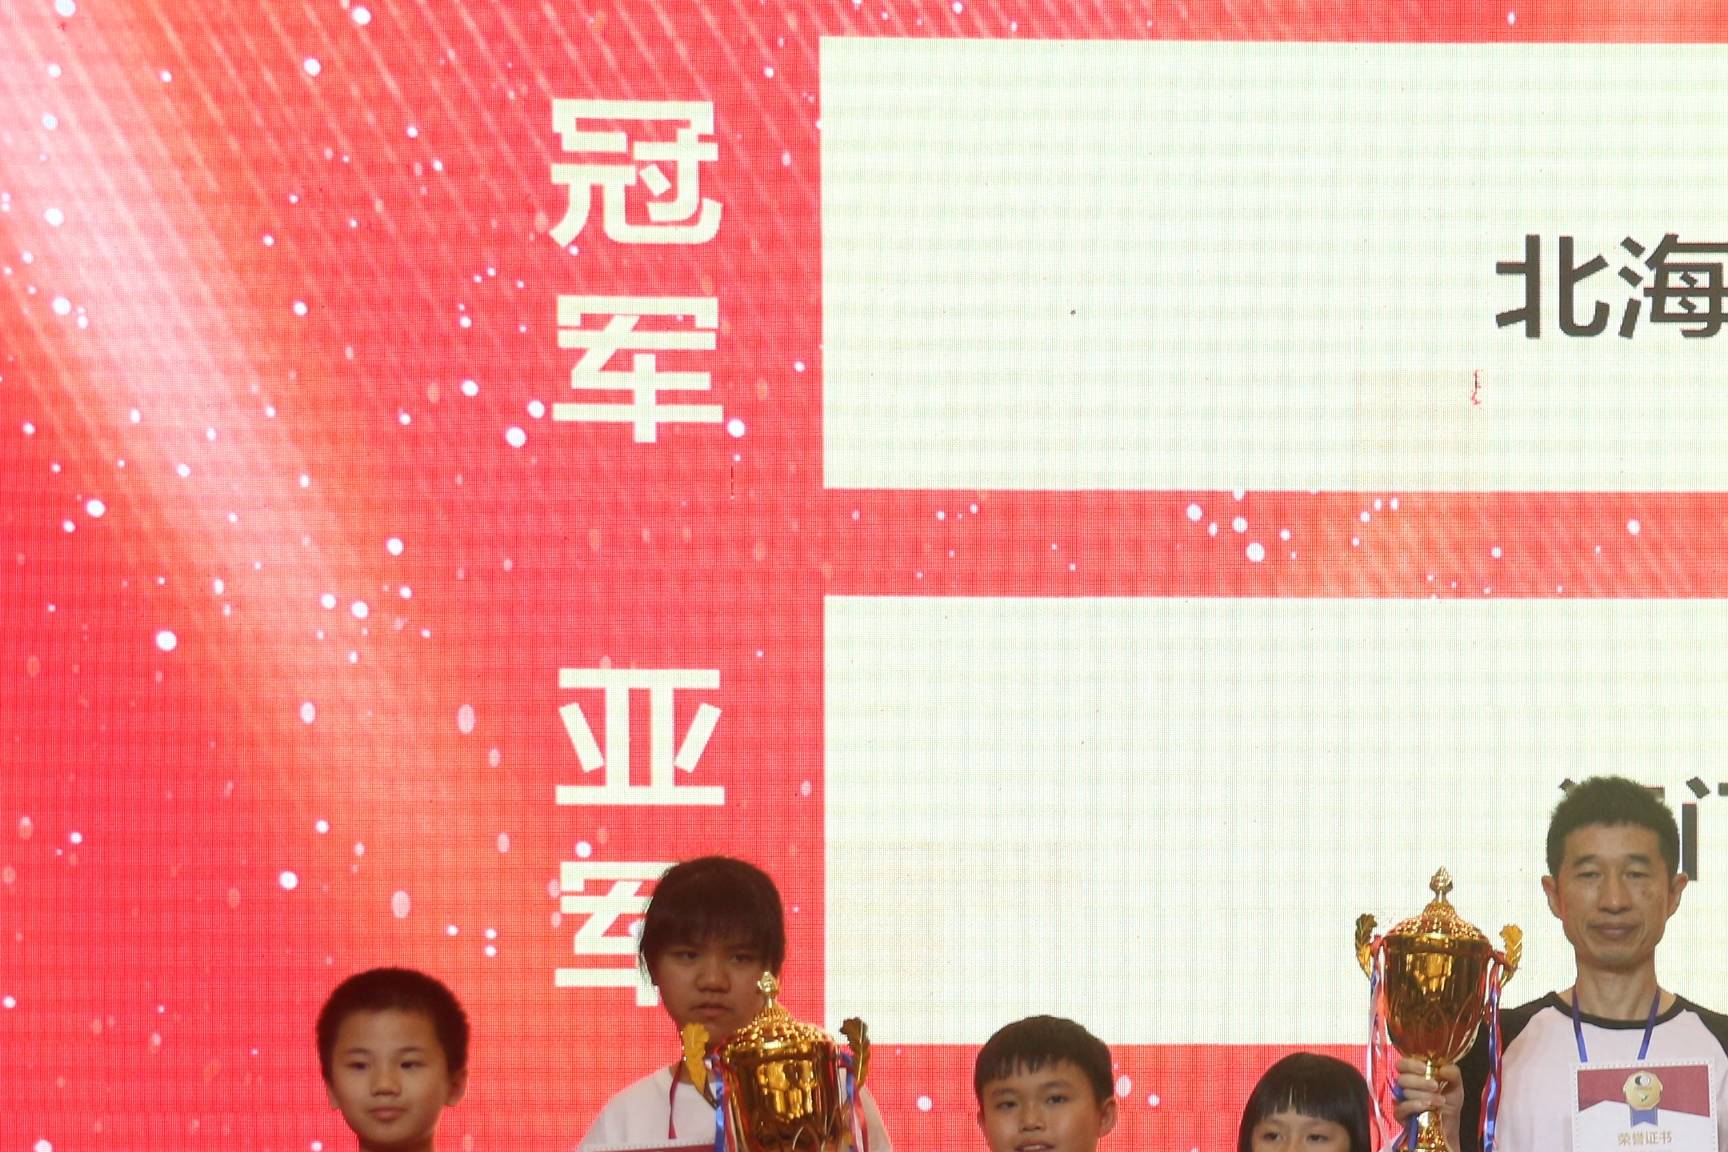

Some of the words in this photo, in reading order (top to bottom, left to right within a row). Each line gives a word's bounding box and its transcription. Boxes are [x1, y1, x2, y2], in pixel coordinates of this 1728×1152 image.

[550, 98, 724, 443] 冠军
[1617, 1131, 1673, 1146] 荣誉证书
